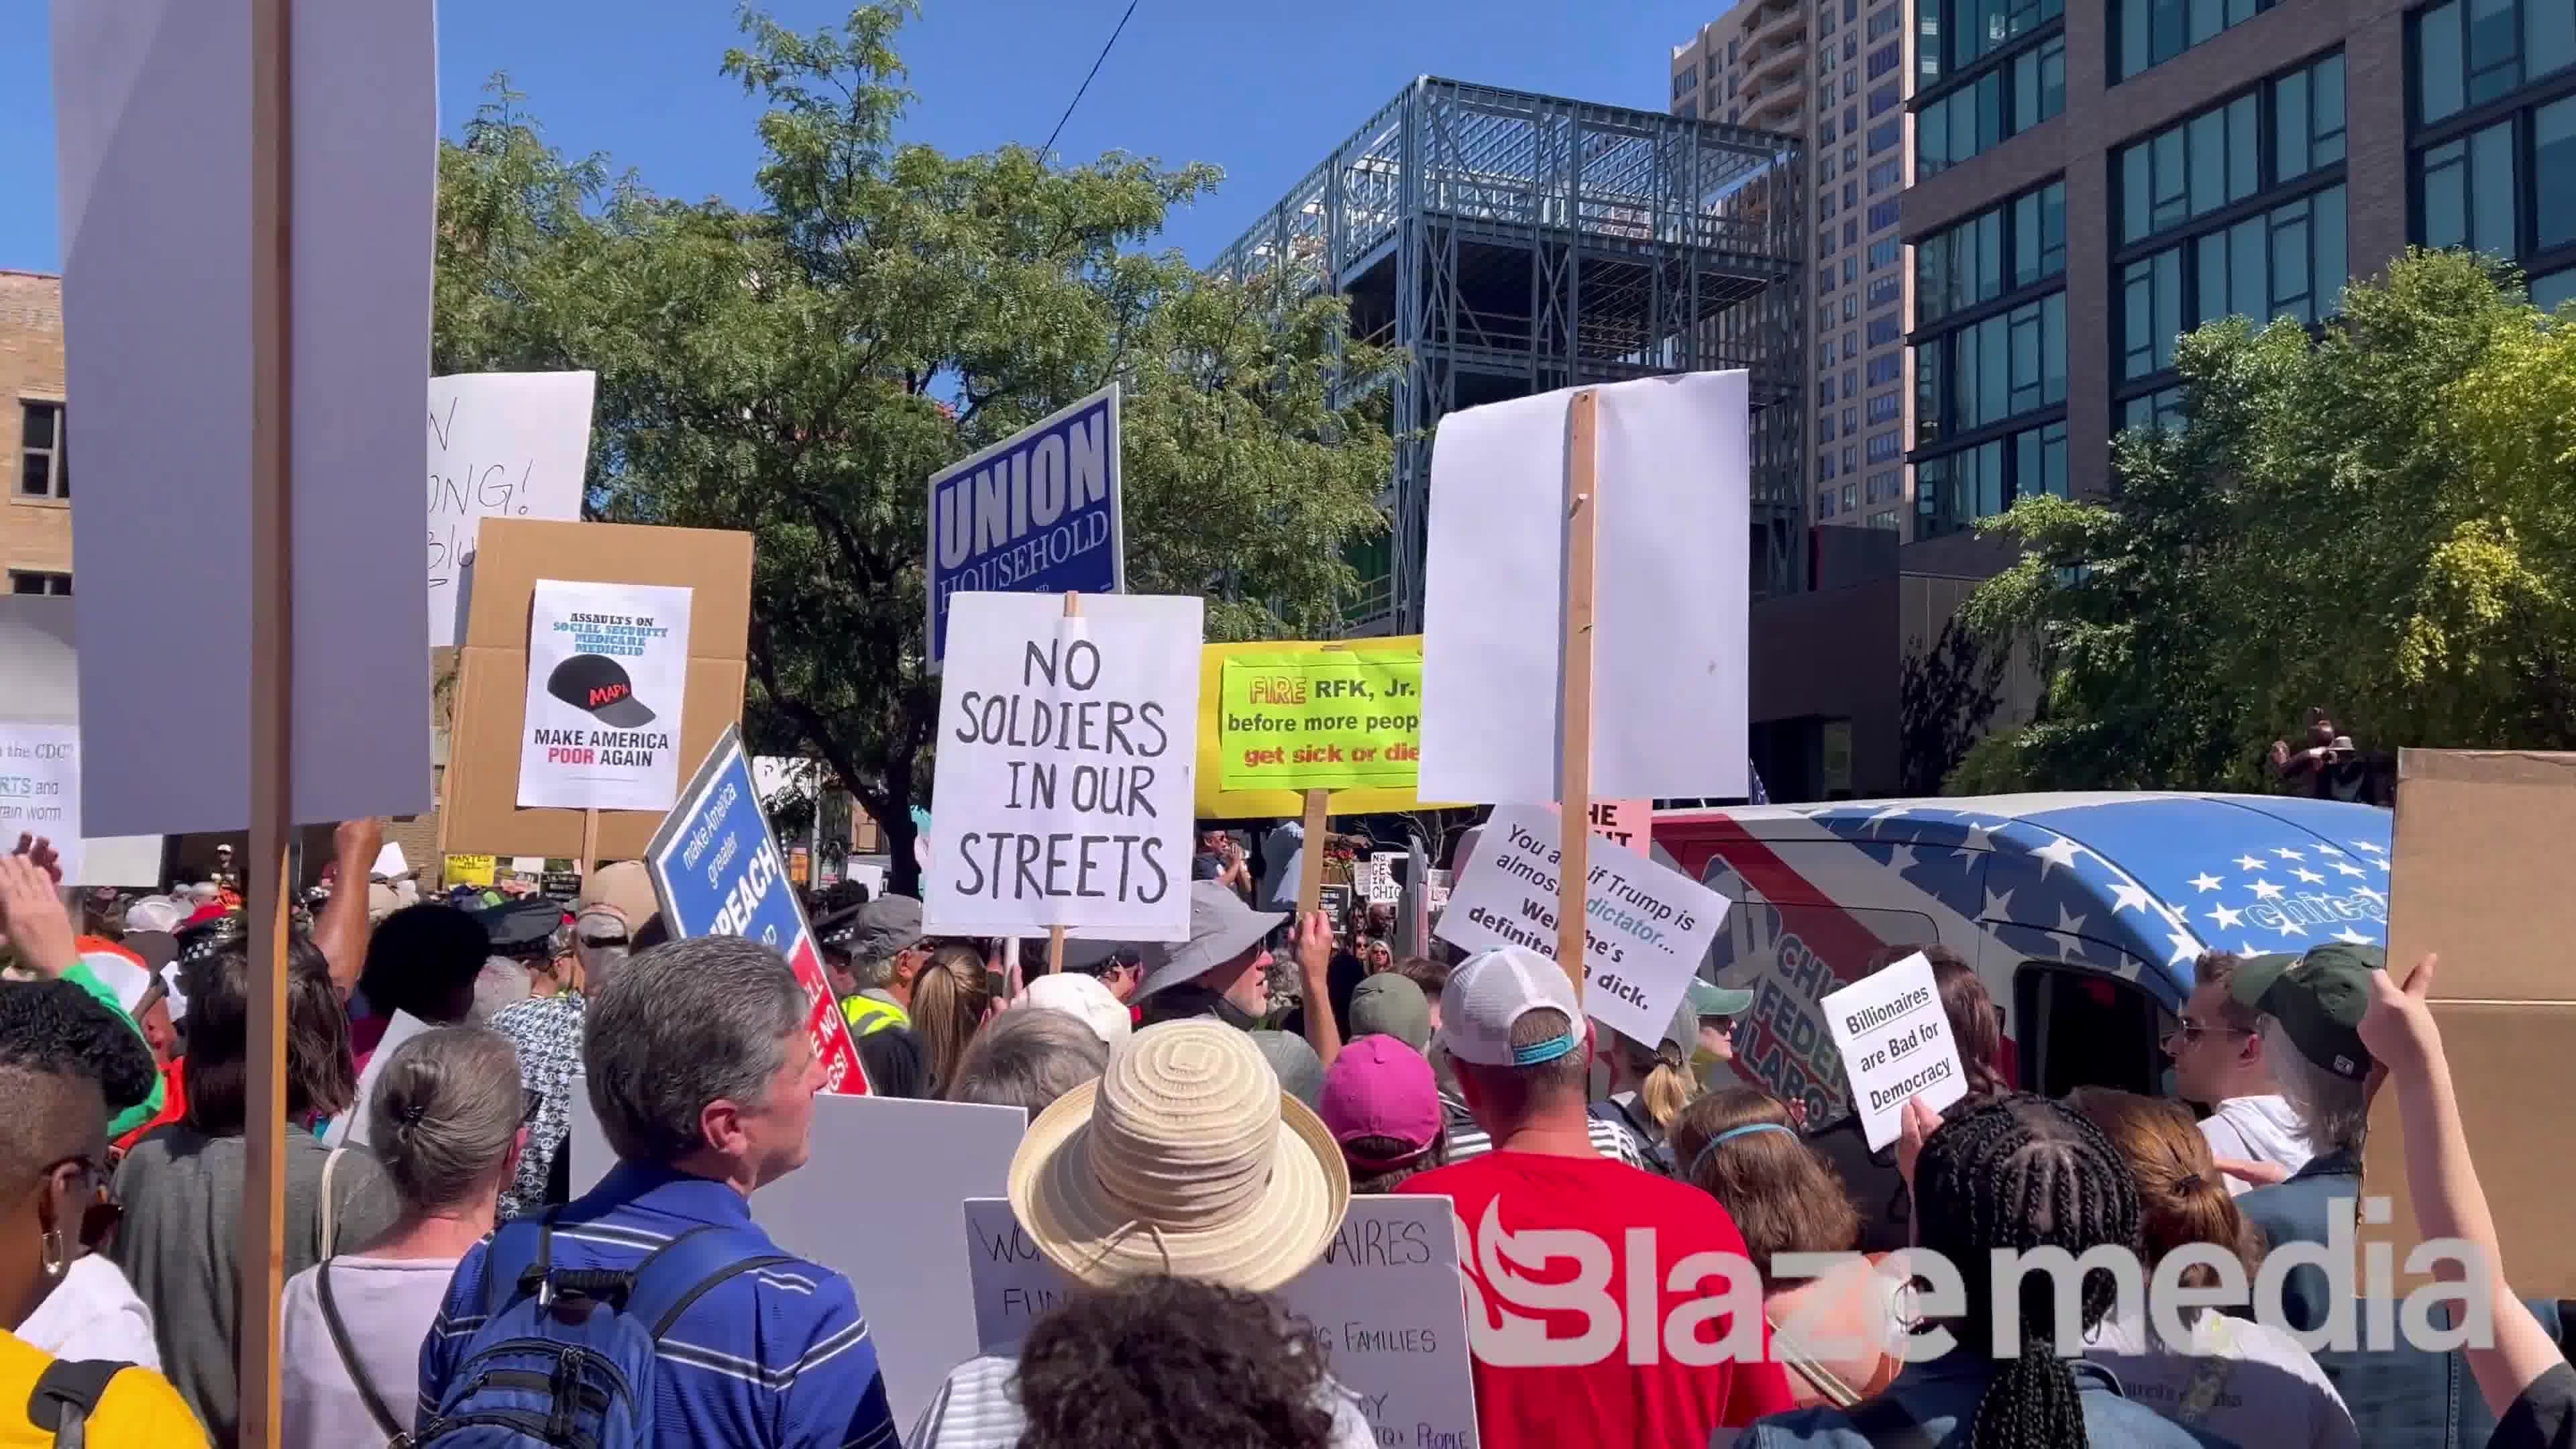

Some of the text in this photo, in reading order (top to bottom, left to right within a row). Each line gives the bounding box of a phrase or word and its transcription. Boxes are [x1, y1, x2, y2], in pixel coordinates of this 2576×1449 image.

[939, 409, 1106, 570] UNION
[939, 510, 1108, 614] HOUSEHOLD
[553, 622, 668, 637] SOCIAL SECURITY
[570, 613, 654, 627] ASSAULTS ON
[574, 633, 646, 646] MEDICARE
[574, 644, 644, 656] MEDICAID
[1023, 637, 1101, 691] NO
[1249, 676, 1415, 705] FIRE RFK, Jr.
[534, 729, 669, 749] MAKE AMERICA
[955, 690, 1168, 757] SOLDIERS
[1228, 713, 1421, 733] before more peop
[7, 743, 31, 757] the
[547, 747, 653, 767] POOR AGAIN
[1244, 746, 1284, 768] get
[1292, 743, 1344, 764] sick
[1351, 746, 1377, 762] or
[36, 780, 59, 795] and
[1004, 761, 1158, 818] IN OUR
[683, 783, 737, 871] make America
[708, 831, 737, 890] greater
[955, 832, 1169, 904] STREETS
[1373, 854, 1386, 862] NO
[1507, 822, 1545, 857] You
[1587, 865, 1609, 885] if
[1610, 874, 1672, 921] Trump
[1674, 909, 1696, 932] is
[1373, 876, 1385, 884] IN
[1585, 896, 1675, 956] dictator...
[1585, 929, 1625, 965] he's
[1776, 932, 1848, 1005] CHI
[1597, 972, 1649, 1010] dick.
[818, 1004, 838, 1043] NO
[1845, 985, 1929, 1036] Billionaires
[1860, 1020, 1940, 1072] are Bad for
[1870, 1056, 1953, 1111] Democracy
[973, 1218, 1430, 1267] WO AIRES
[1313, 1321, 1437, 1353] G FAMILIES
